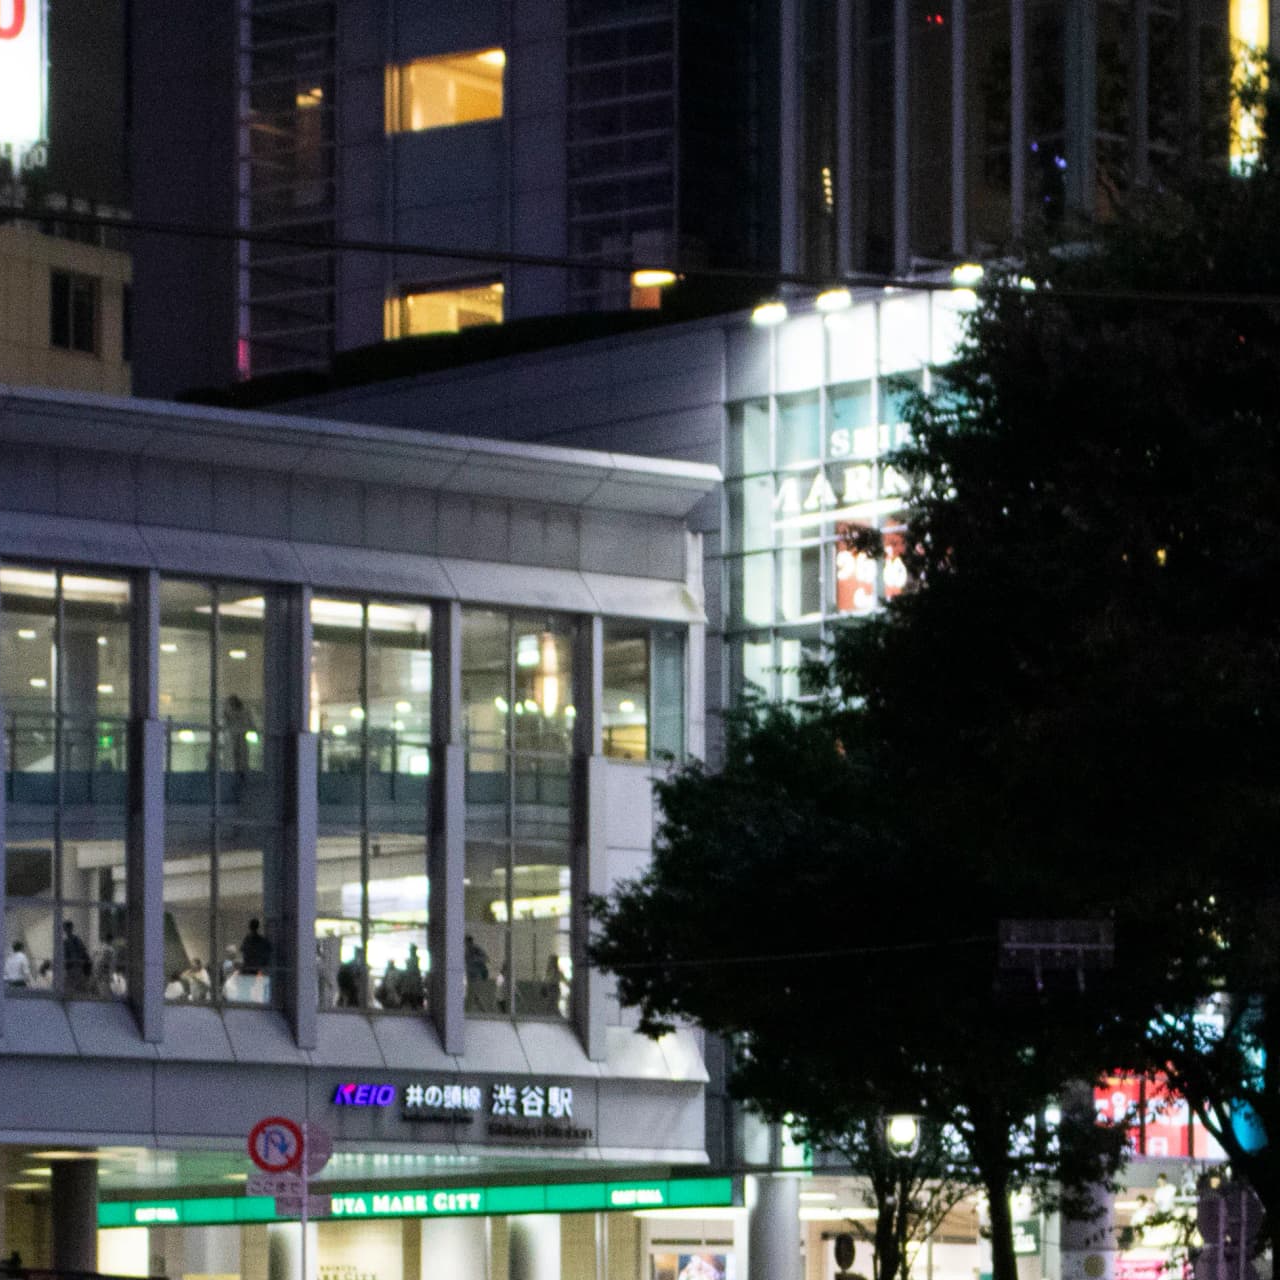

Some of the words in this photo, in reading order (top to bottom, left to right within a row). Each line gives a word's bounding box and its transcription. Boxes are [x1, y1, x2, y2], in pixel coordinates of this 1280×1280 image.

[333, 1084, 395, 1106] KEIO
[405, 1084, 482, 1110] 井の頭線
[492, 1083, 573, 1118] 渋谷駅
[373, 1194, 428, 1214] MARK
[433, 1192, 481, 1211] CITY
